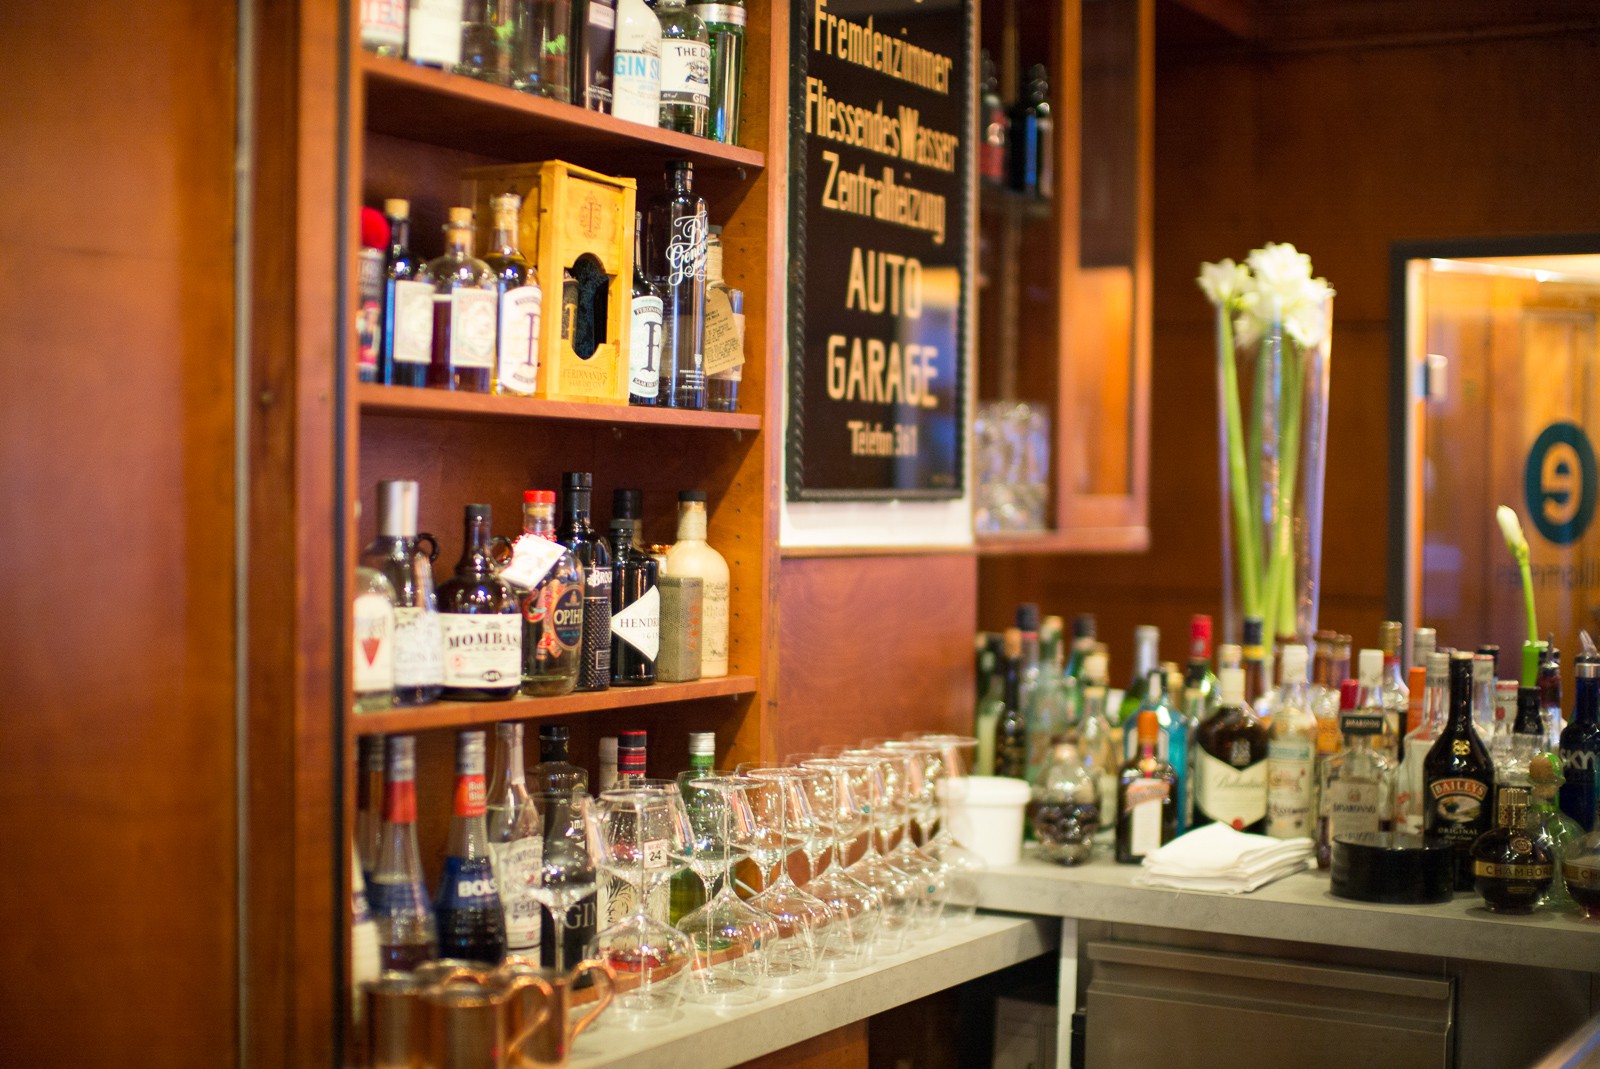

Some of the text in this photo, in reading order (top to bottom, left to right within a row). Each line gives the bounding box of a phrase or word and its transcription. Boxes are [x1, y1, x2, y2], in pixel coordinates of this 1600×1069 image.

[674, 46, 698, 57] THE
[814, 0, 953, 95] Fremdenzimmer
[614, 54, 646, 77] GIN
[692, 93, 707, 105] GIN
[805, 76, 959, 173] Fliessendes Wasser
[822, 150, 946, 245] Zentralheizung
[846, 247, 923, 319] AUTO
[827, 335, 939, 408] GARAGE
[847, 420, 893, 456] Telefon
[1435, 781, 1484, 796] BAILEYS
[650, 850, 662, 862] 24
[458, 879, 498, 898] BOLS
